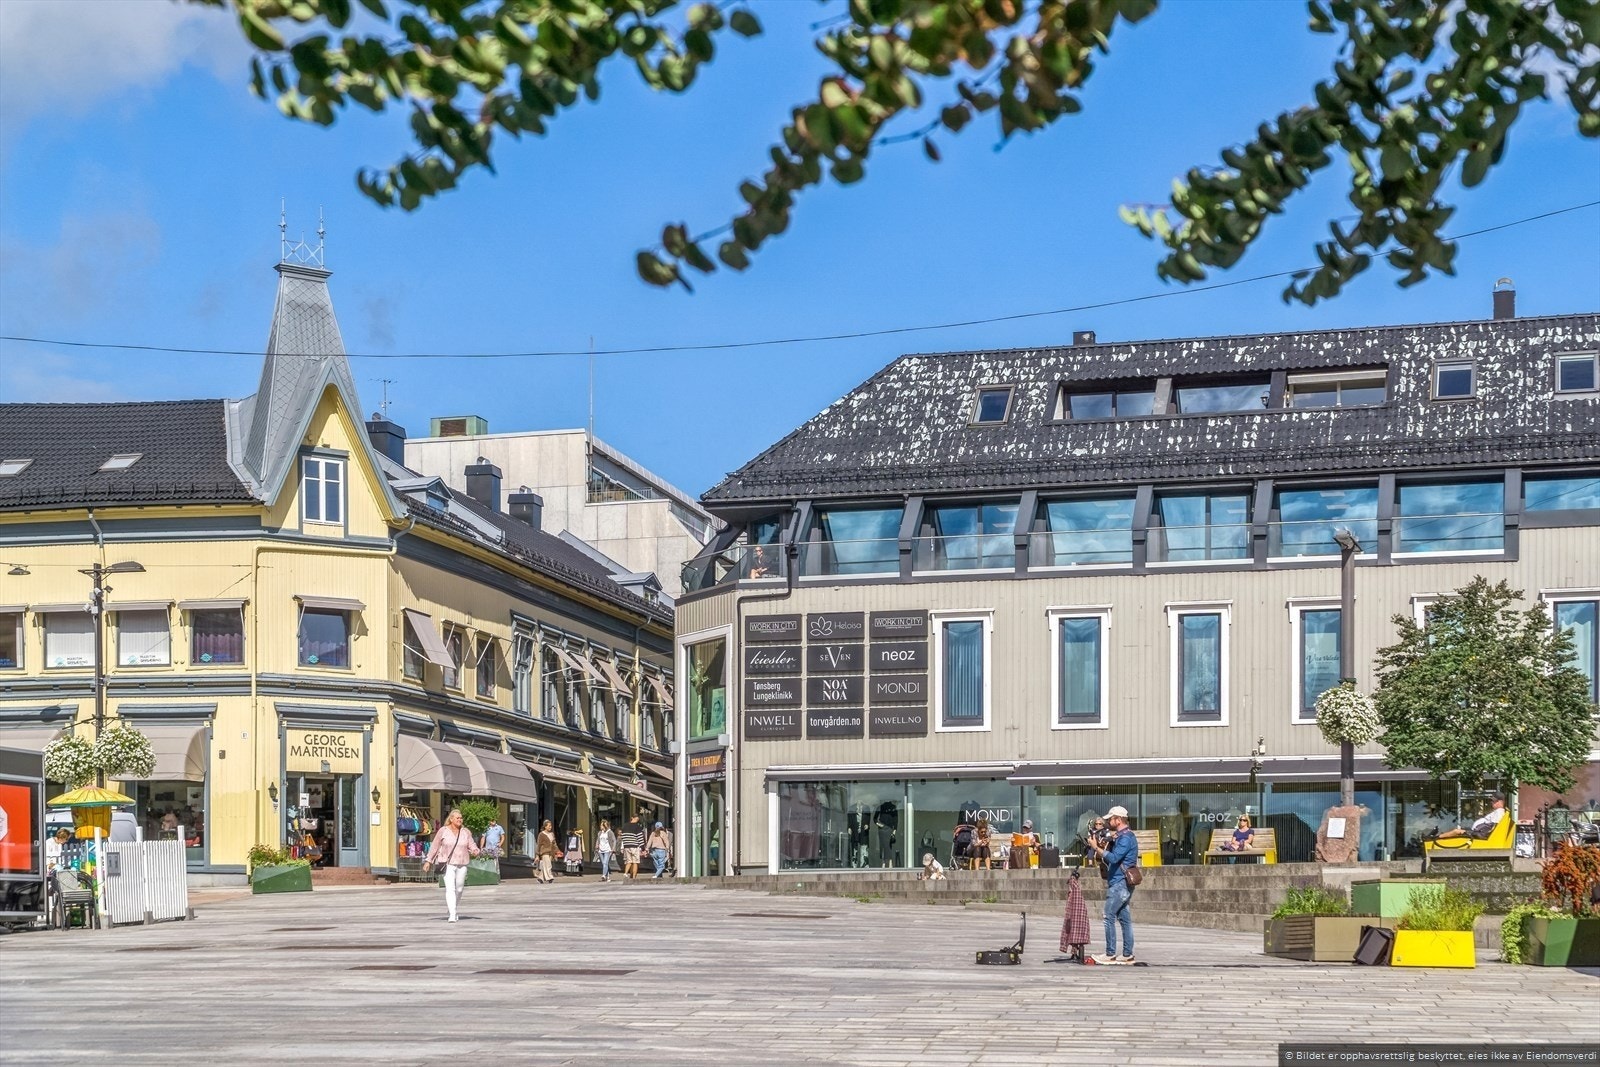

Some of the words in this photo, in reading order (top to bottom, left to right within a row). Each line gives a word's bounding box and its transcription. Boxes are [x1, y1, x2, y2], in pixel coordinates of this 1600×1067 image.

[751, 622, 771, 630] WORK
[772, 622, 779, 630] IN
[781, 621, 795, 629] CITY
[876, 619, 897, 627] WORK
[897, 618, 905, 626] IN
[906, 617, 921, 625] CITY
[750, 650, 797, 665] kiesler
[881, 650, 915, 661] neoz
[753, 681, 781, 691] Tønsberg
[822, 679, 848, 690] NOA
[877, 682, 920, 694] MONDI
[753, 691, 793, 701] Lungeklinikk
[822, 690, 848, 701] NOA
[750, 715, 795, 726] INWELL
[810, 715, 861, 729] torvgården.no
[874, 716, 922, 725] INWELL.NO
[304, 734, 346, 746] GEORG
[290, 745, 359, 759] MARTINSEN
[965, 809, 1013, 821] MONDI
[1199, 812, 1232, 822] neoz
